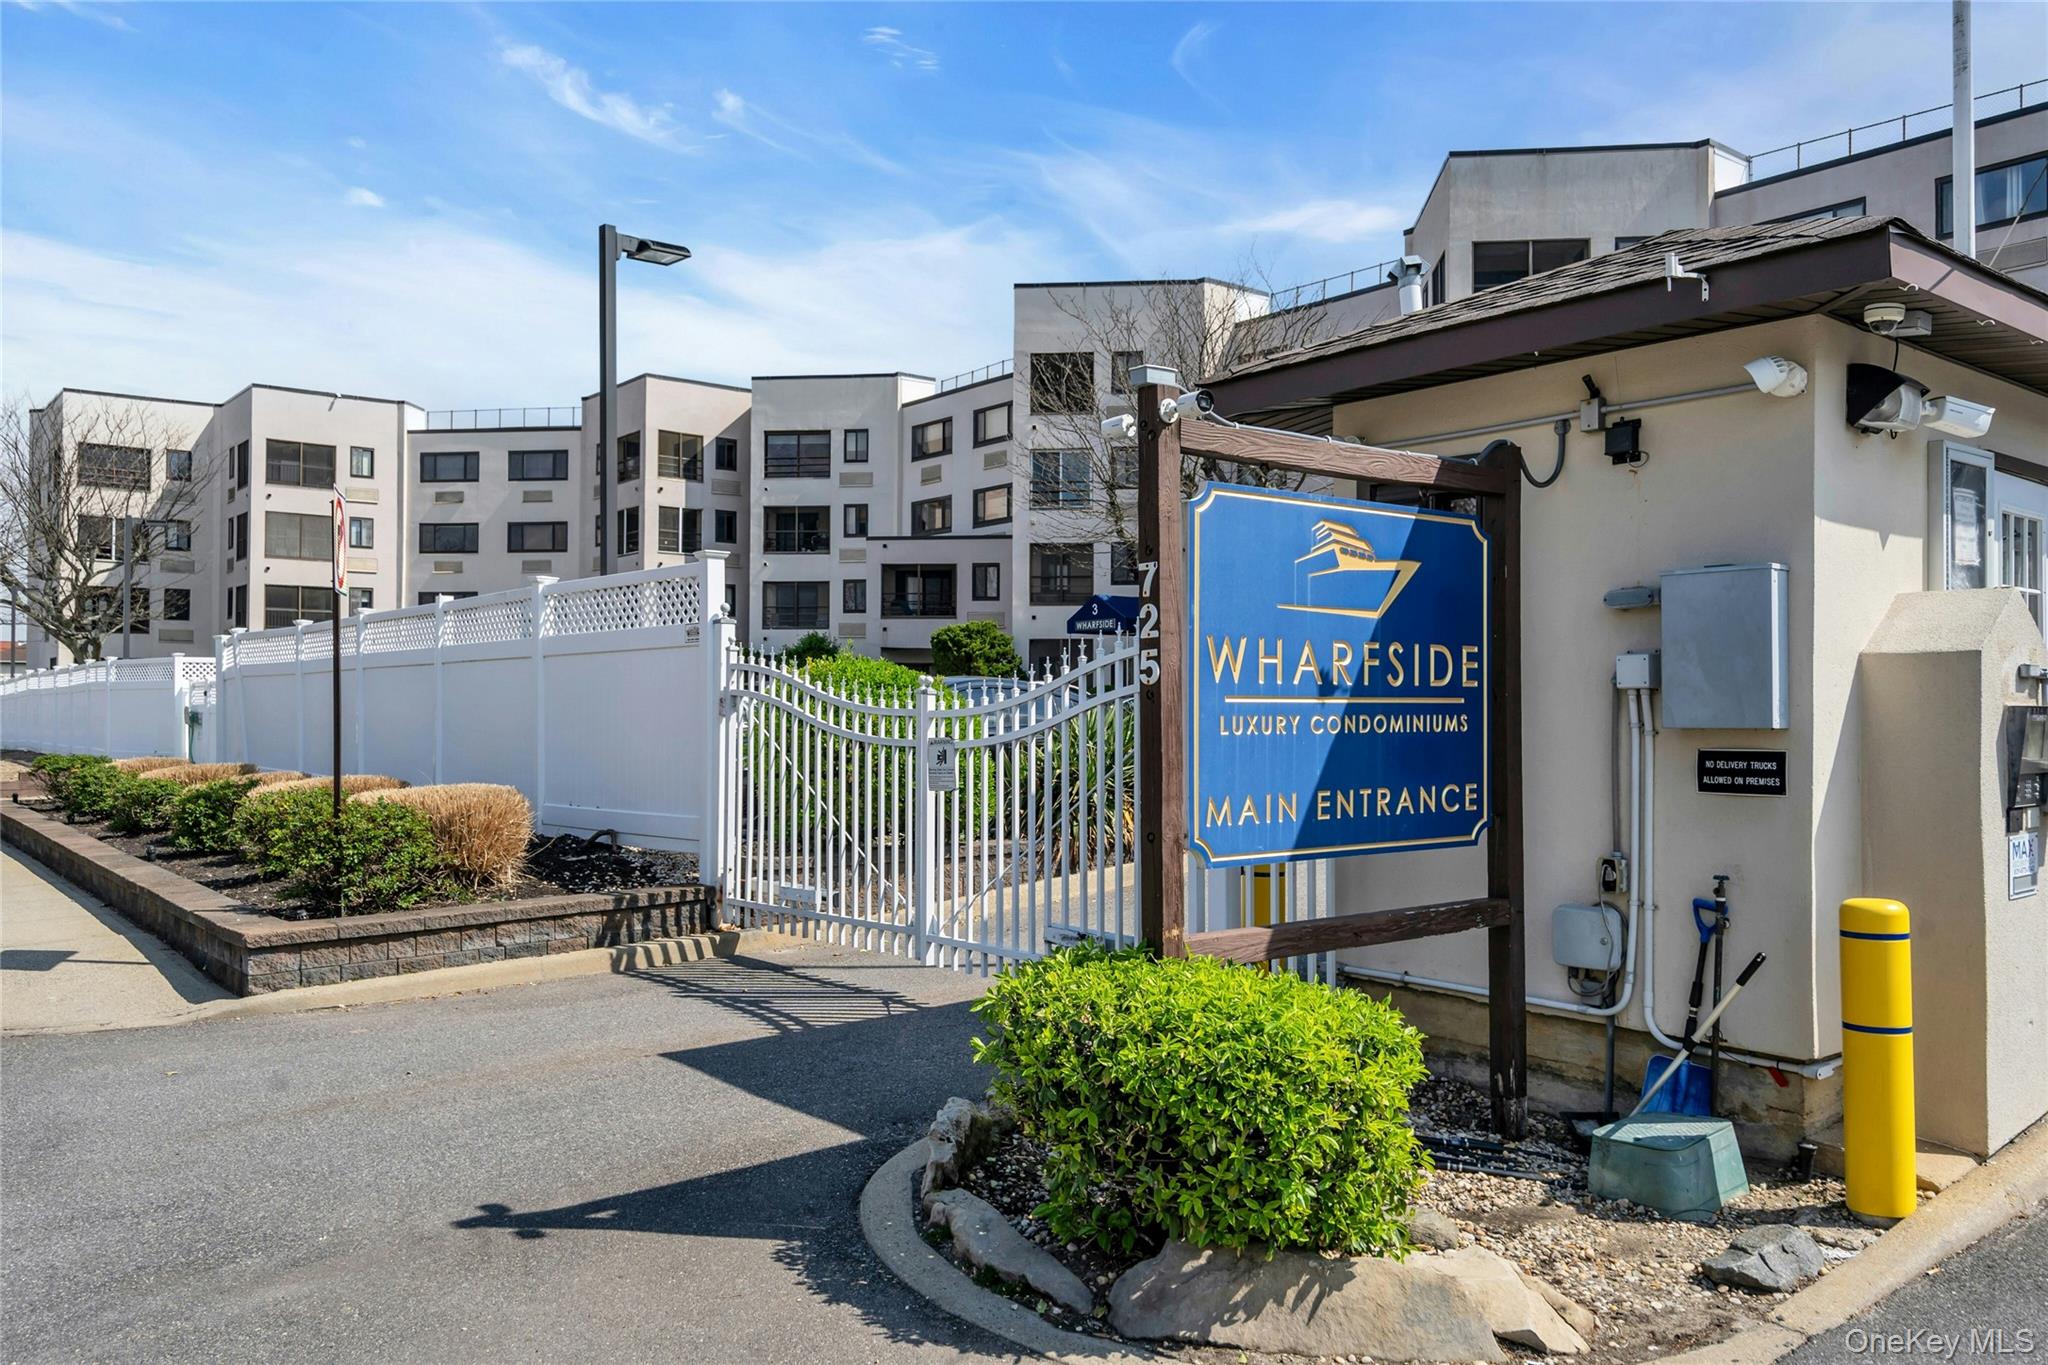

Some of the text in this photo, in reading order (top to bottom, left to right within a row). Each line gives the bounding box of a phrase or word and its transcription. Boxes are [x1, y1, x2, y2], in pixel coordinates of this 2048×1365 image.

[1091, 603, 1099, 616] 3
[1076, 619, 1113, 630] WHARFSIDE
[1138, 560, 1160, 686] 725
[1206, 634, 1479, 688] WHARFSIDE
[1219, 713, 1469, 736] LUXURY CONDOMINIUMS
[1705, 760, 1777, 770] NO DELIVERY TRUCKS
[1703, 775, 1781, 786] ALLOWED ON PREMISES
[1205, 782, 1478, 828] MAIN ENTRANCE
